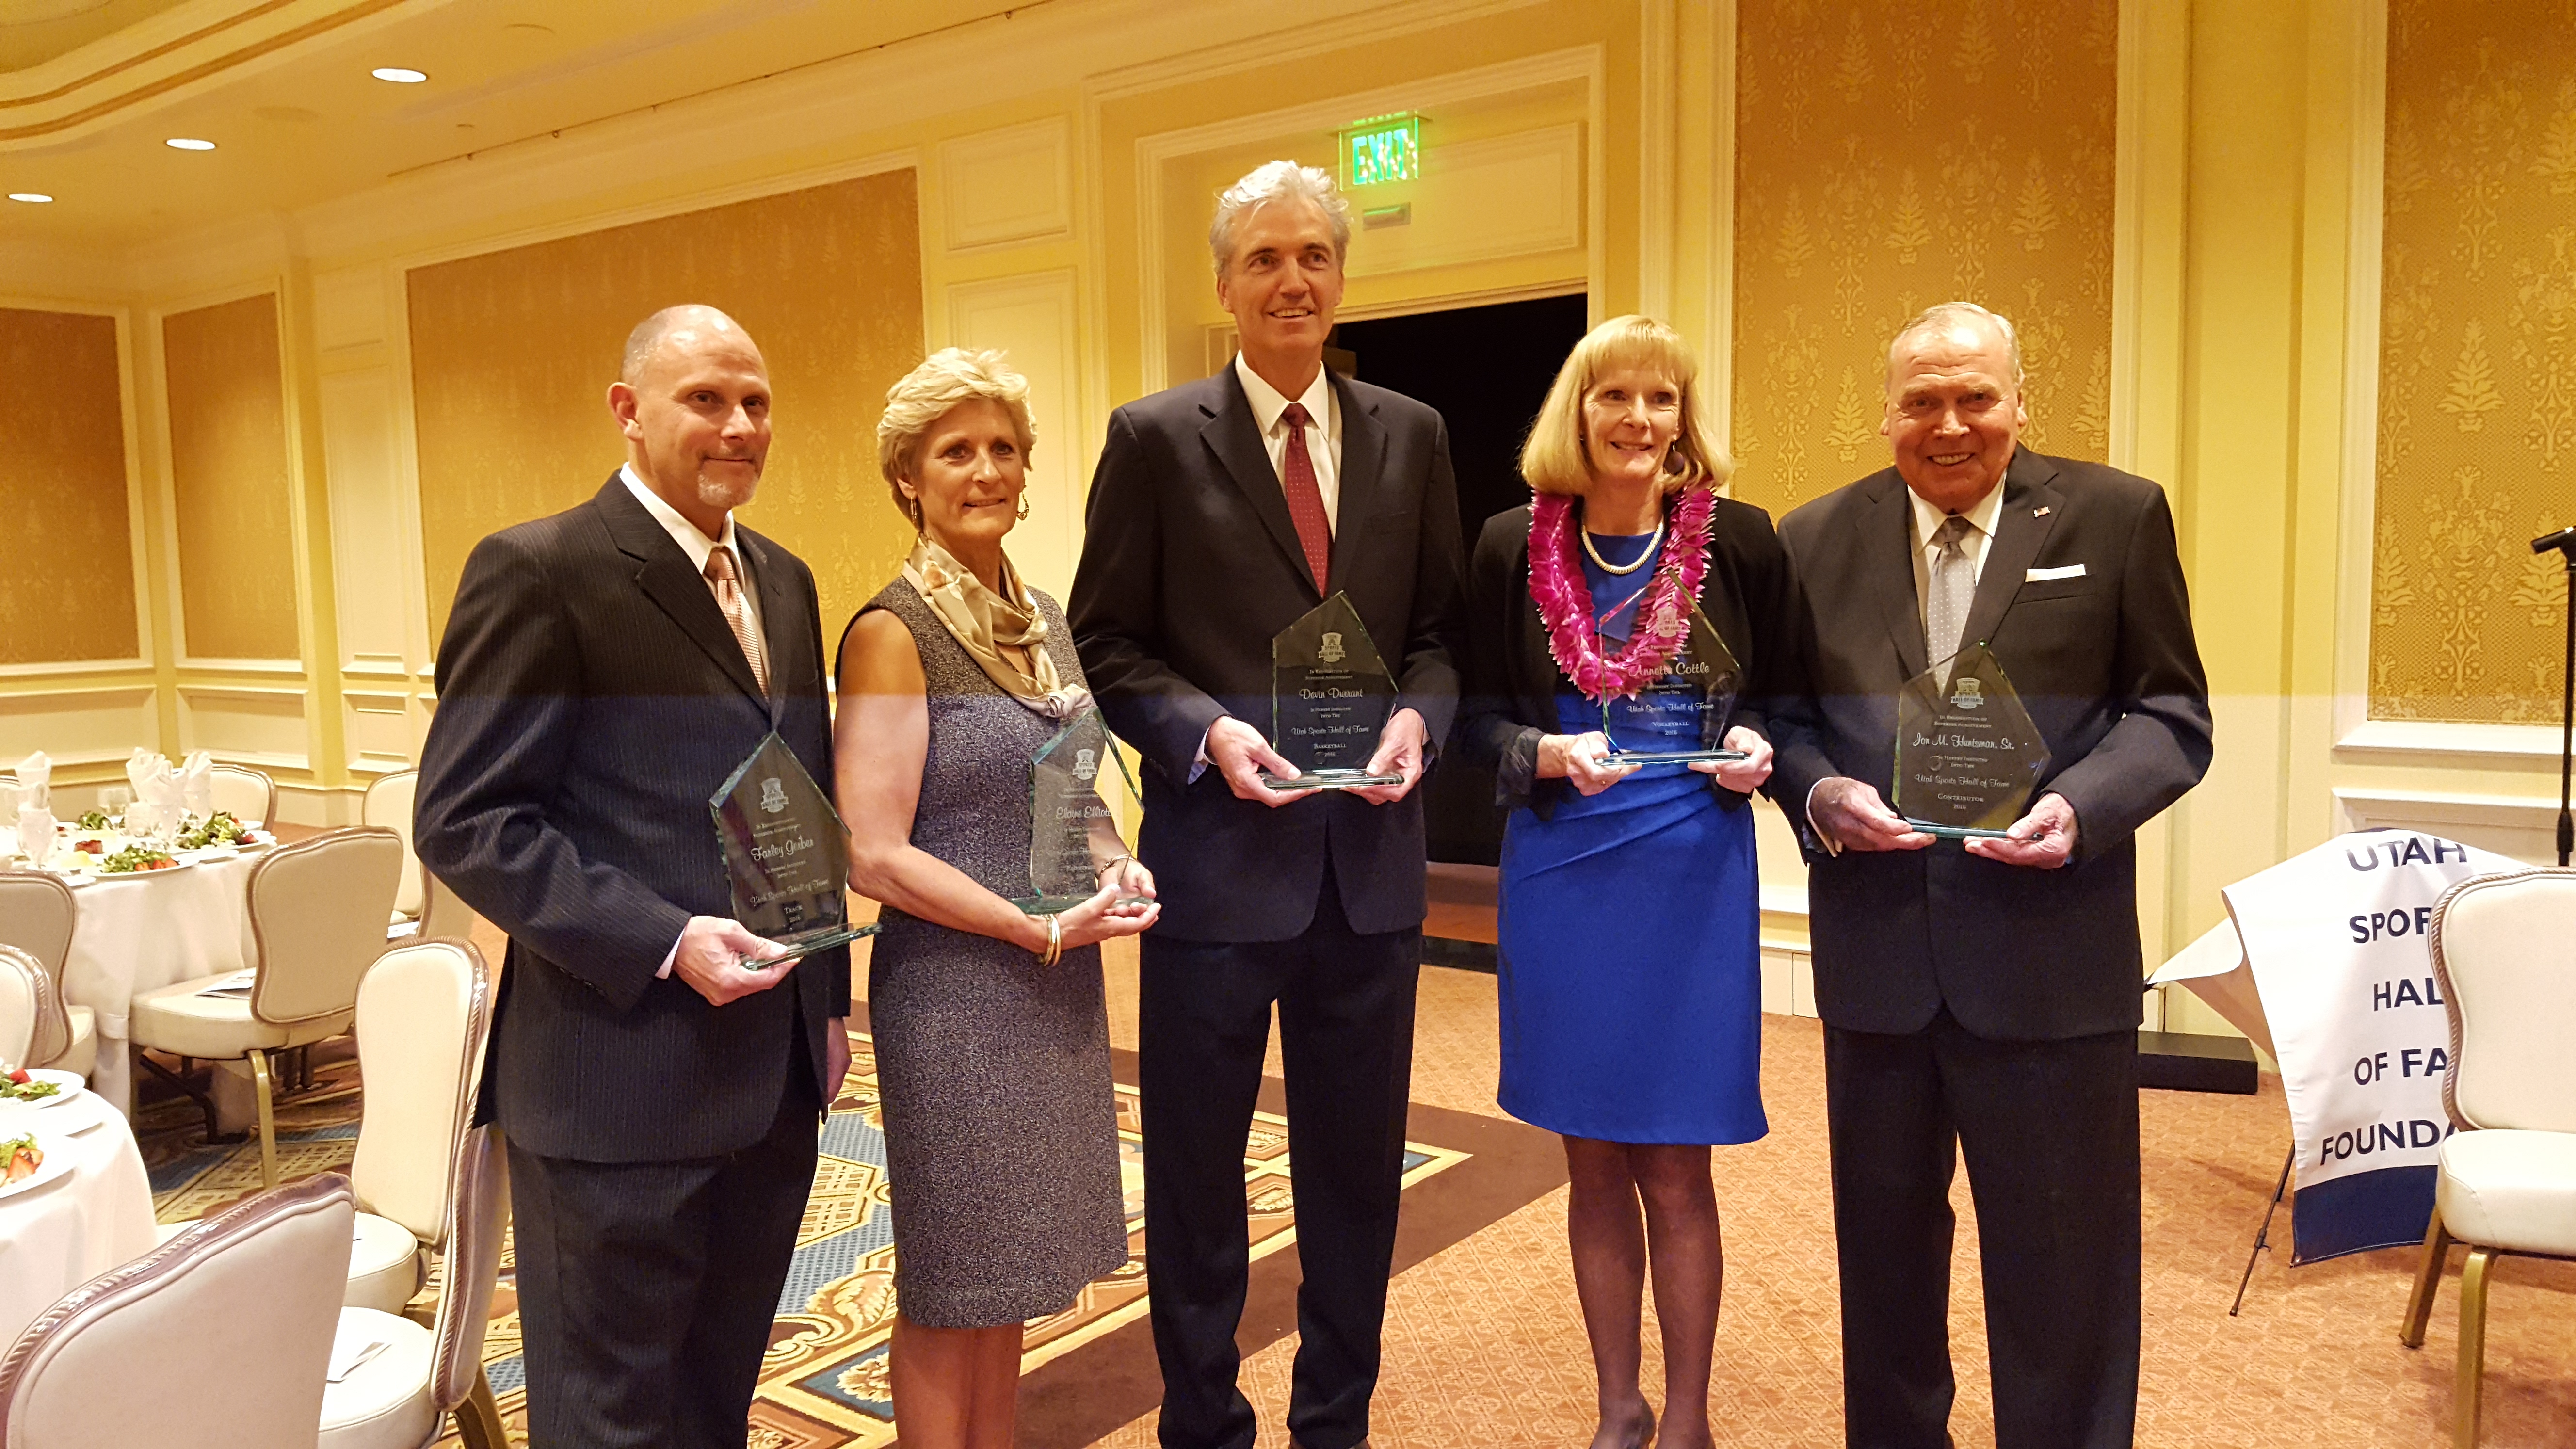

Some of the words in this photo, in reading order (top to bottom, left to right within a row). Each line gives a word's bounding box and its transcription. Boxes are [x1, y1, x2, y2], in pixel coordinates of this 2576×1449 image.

[1352, 129, 1408, 185] EXIT
[1675, 662, 1710, 675] Cottle
[1299, 688, 1325, 699] Devin
[1327, 687, 1363, 698] Durrant
[1667, 703, 1686, 711] Hall
[1687, 703, 1694, 712] of
[1695, 702, 1715, 710] Fame
[1913, 733, 1930, 746] Jon
[1932, 734, 1948, 746] M.
[1914, 774, 1933, 783] Utah
[1935, 775, 1957, 785] Sports
[1959, 776, 1979, 786] Hall
[1980, 778, 1988, 788] of
[1989, 778, 2010, 788] Fame
[751, 844, 784, 861] Farley
[786, 835, 814, 855] Gerber
[2345, 837, 2467, 872] UTAH
[783, 904, 803, 914] TRACK
[2354, 1051, 2388, 1086] OF
